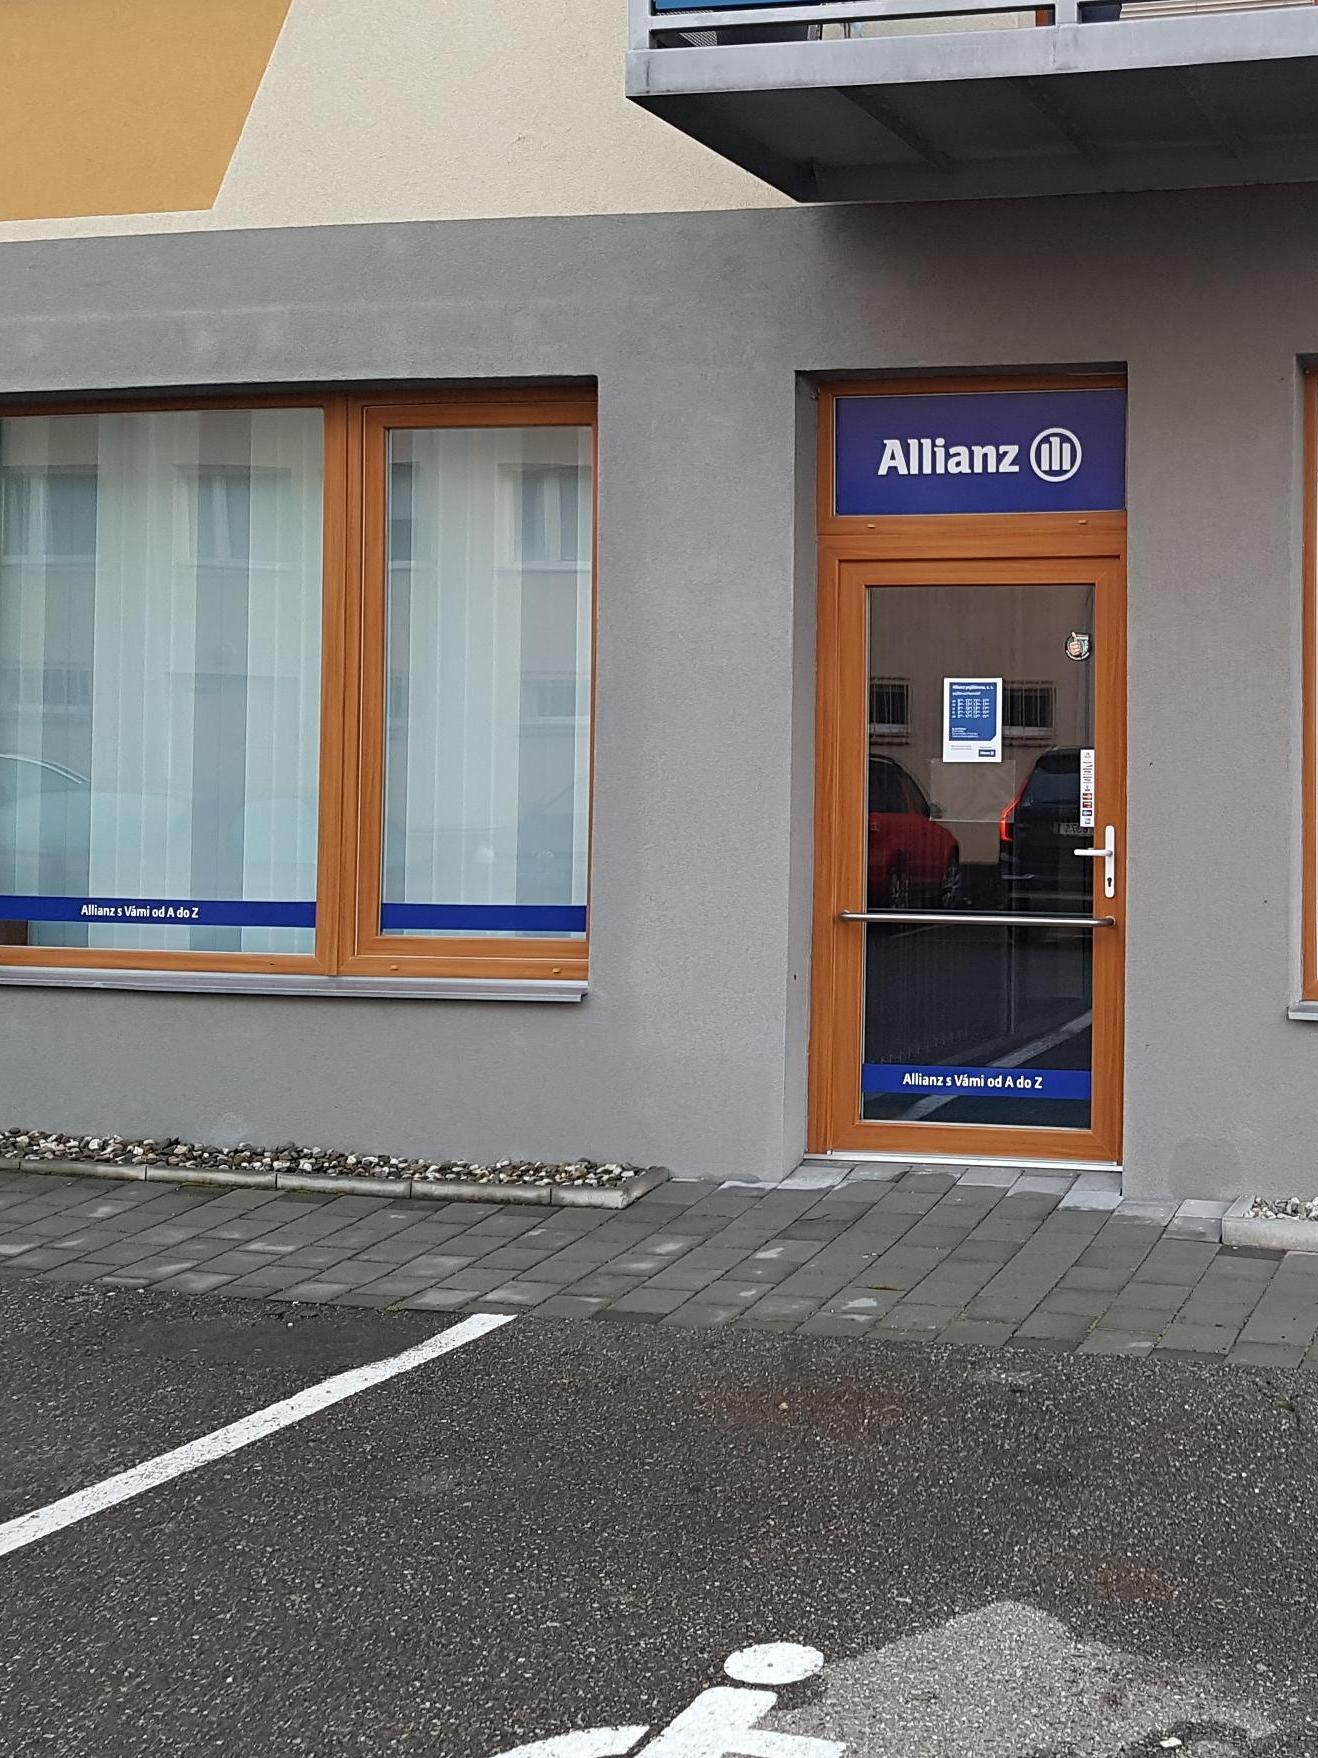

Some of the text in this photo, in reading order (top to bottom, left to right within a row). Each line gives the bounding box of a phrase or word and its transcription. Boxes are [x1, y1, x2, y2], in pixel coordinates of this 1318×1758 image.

[877, 437, 1020, 476] Allianz
[81, 904, 199, 919] Allianz s Vámi od A do Z
[902, 1072, 1043, 1089] Allianz s Vámi od A do Z
